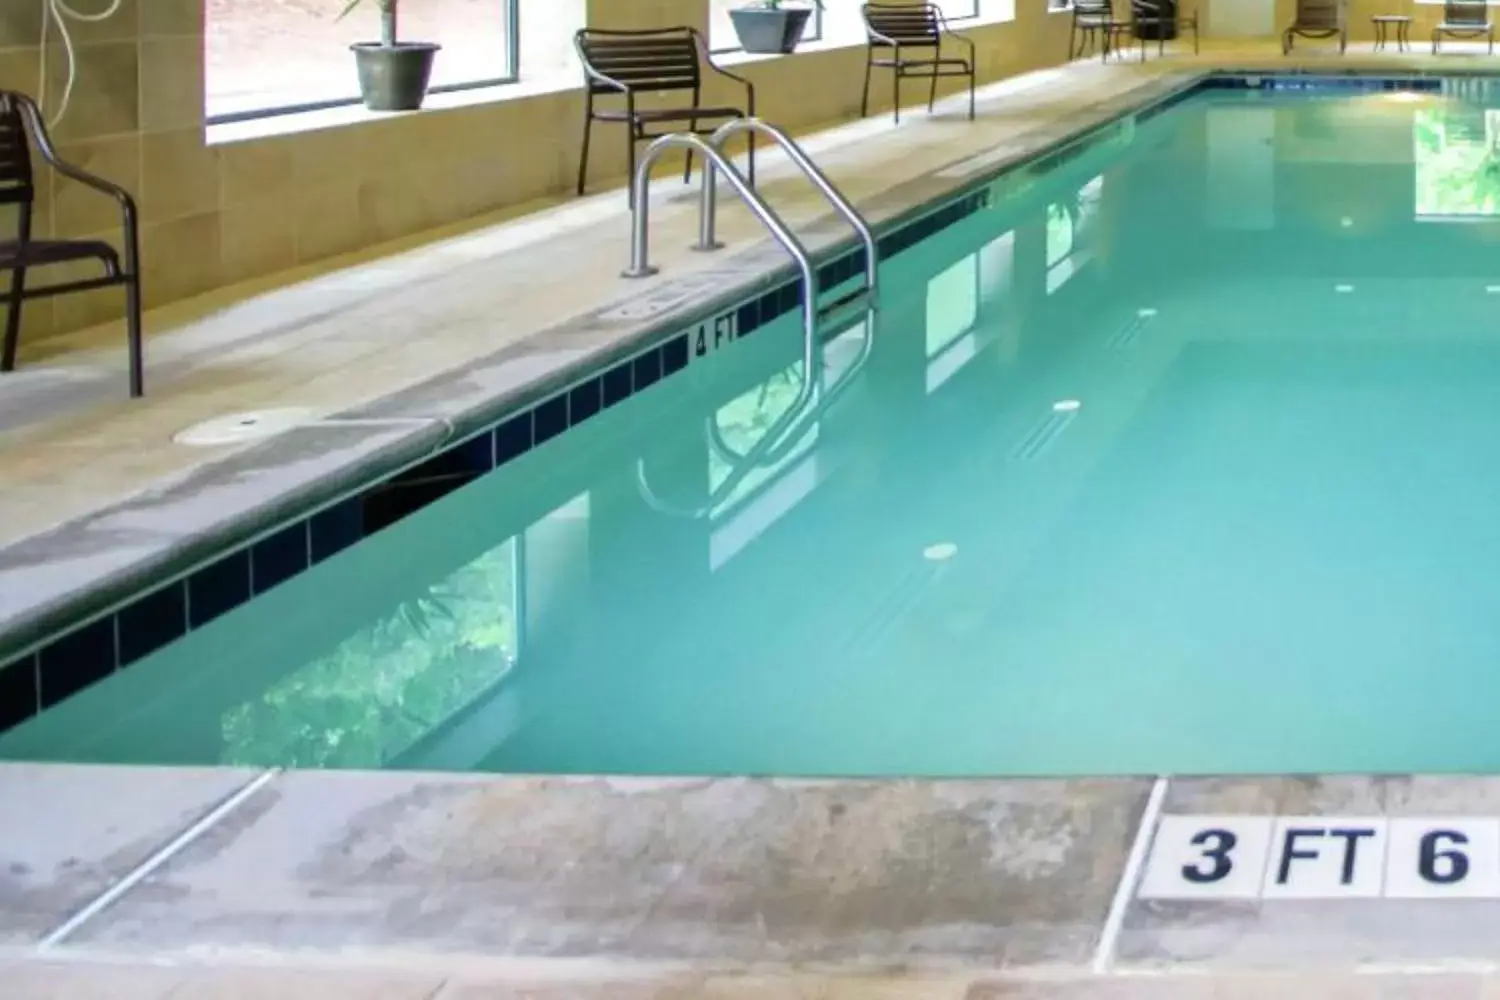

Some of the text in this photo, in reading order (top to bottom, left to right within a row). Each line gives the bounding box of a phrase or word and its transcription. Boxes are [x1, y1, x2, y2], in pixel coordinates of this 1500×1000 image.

[714, 310, 737, 351] FT
[1181, 828, 1236, 883] 3
[1275, 828, 1376, 885] FT
[1418, 828, 1470, 884] 6
